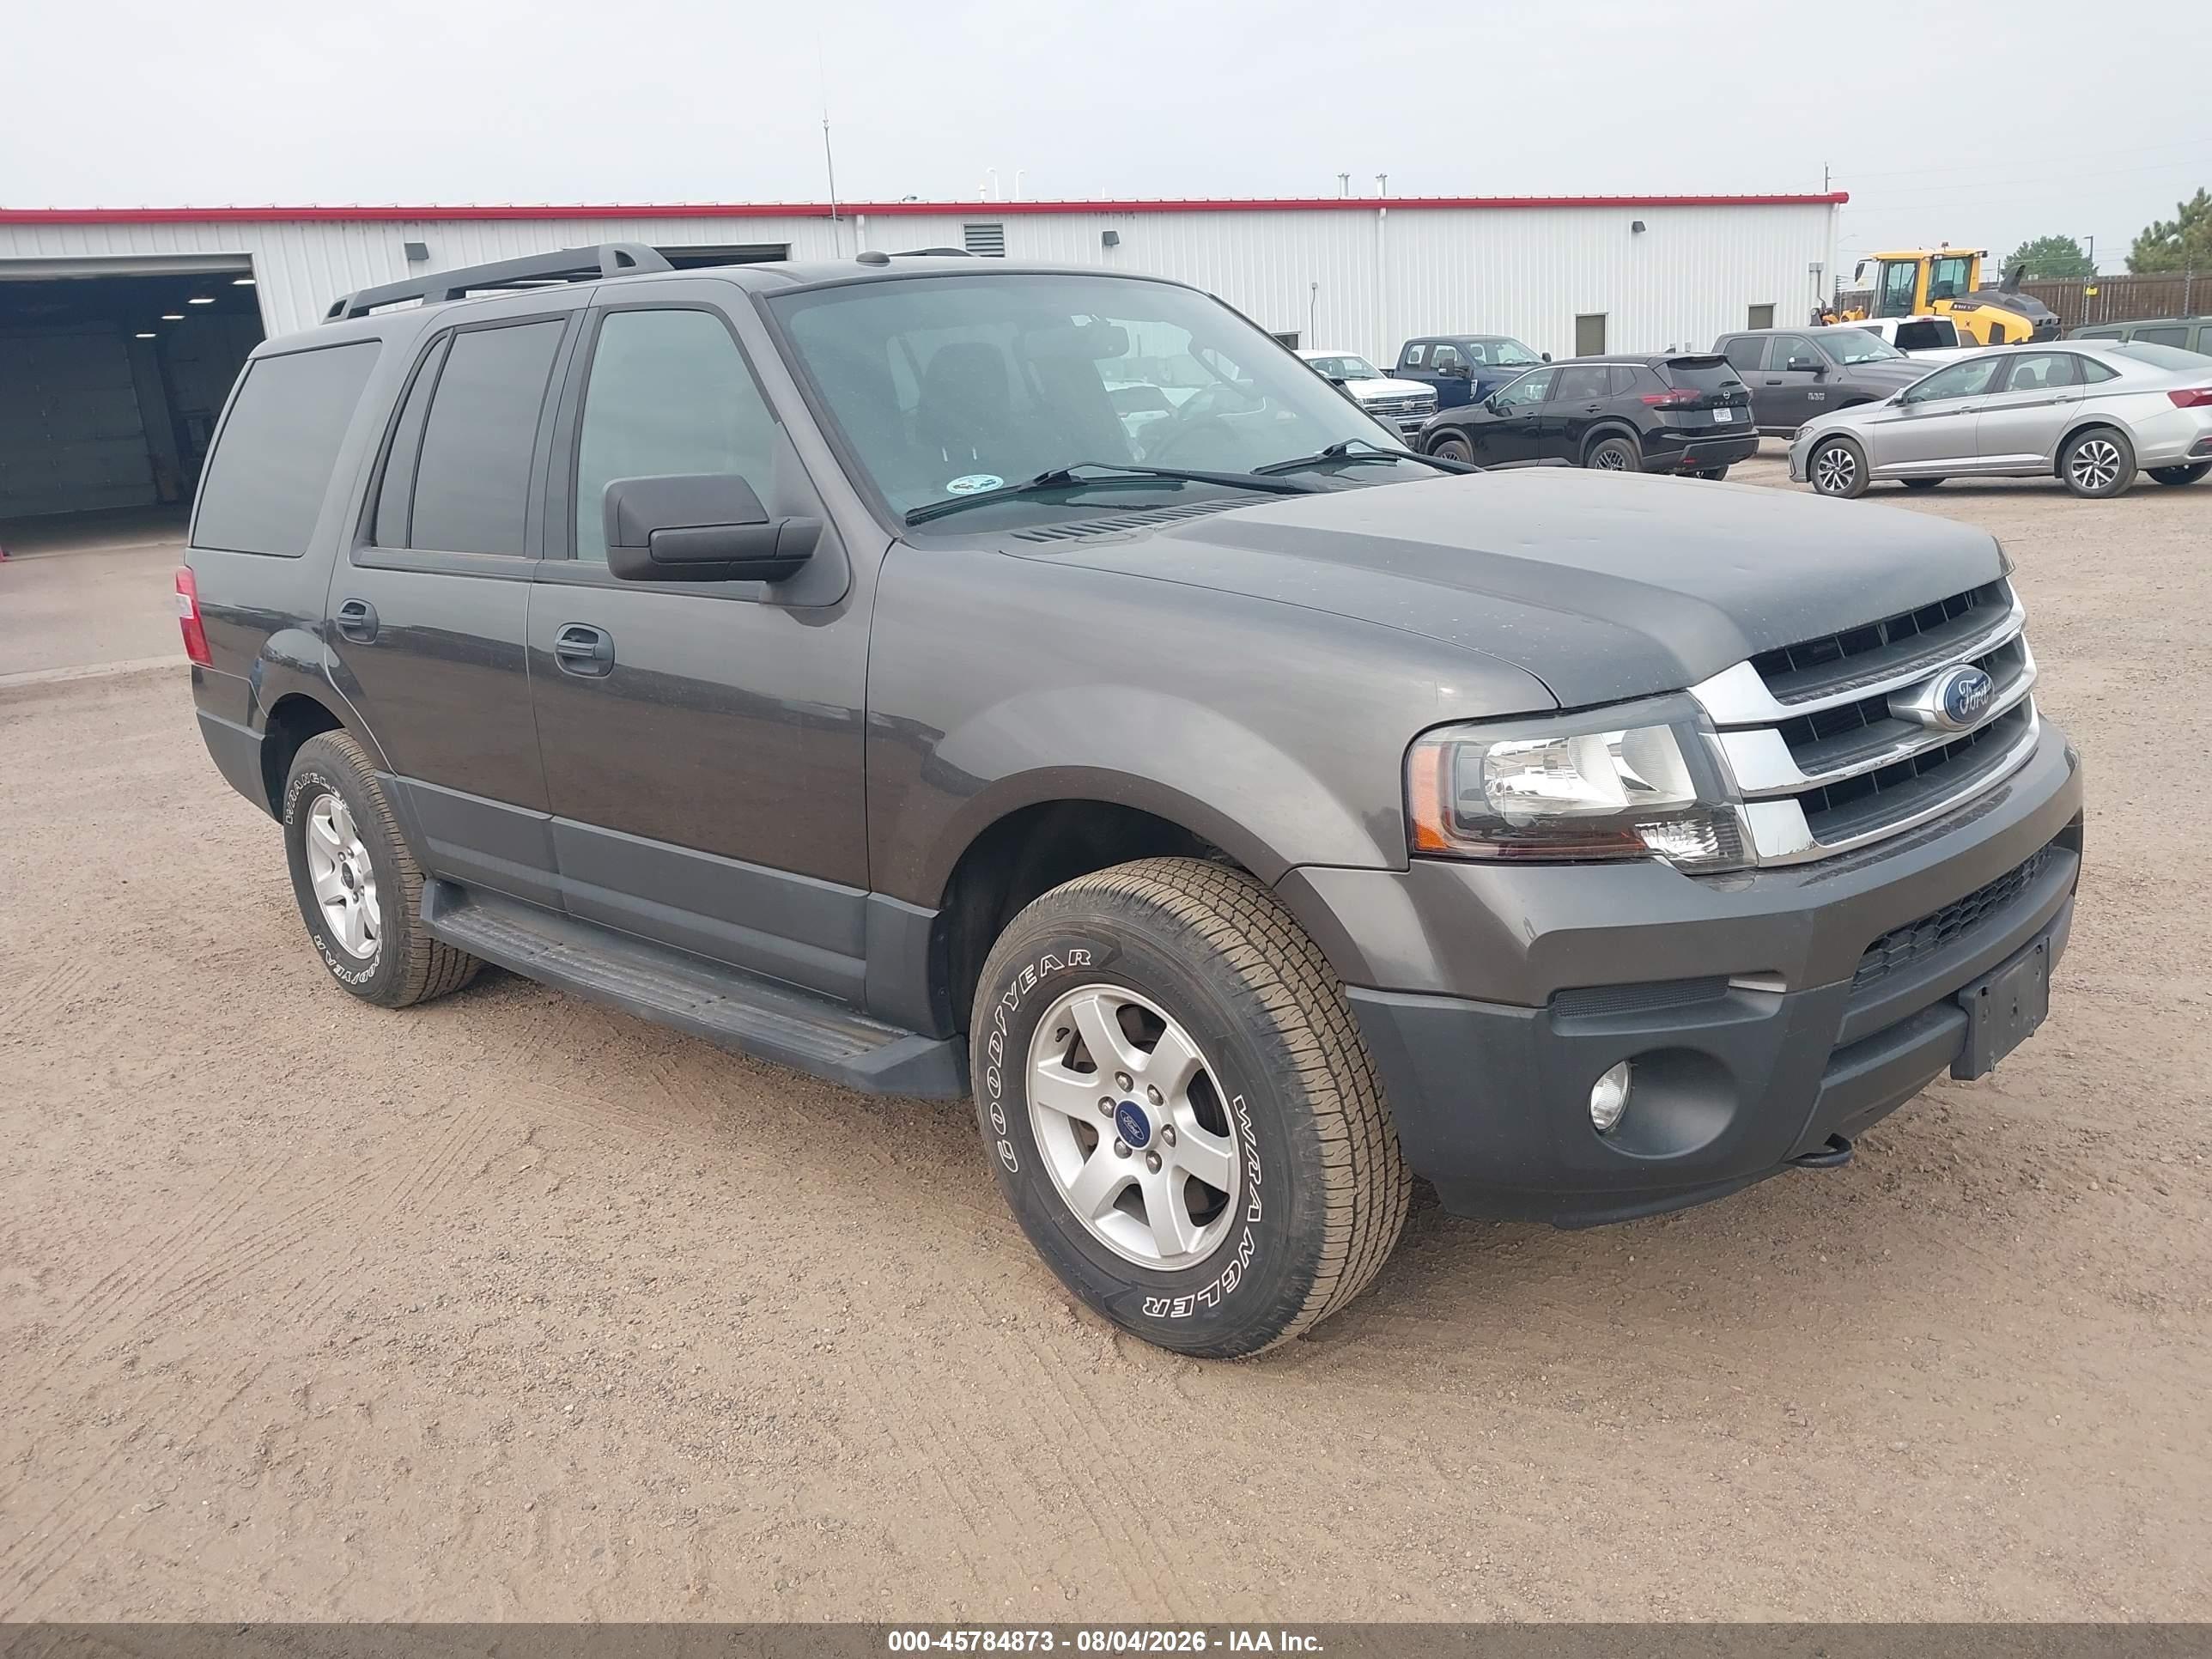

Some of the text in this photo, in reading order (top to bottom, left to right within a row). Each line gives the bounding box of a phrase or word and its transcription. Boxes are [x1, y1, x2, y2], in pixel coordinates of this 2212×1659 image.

[1958, 678, 1992, 714] Ford
[987, 949, 1092, 1174] GOODYEAR
[1142, 1094, 1262, 1318] WRANGLER
